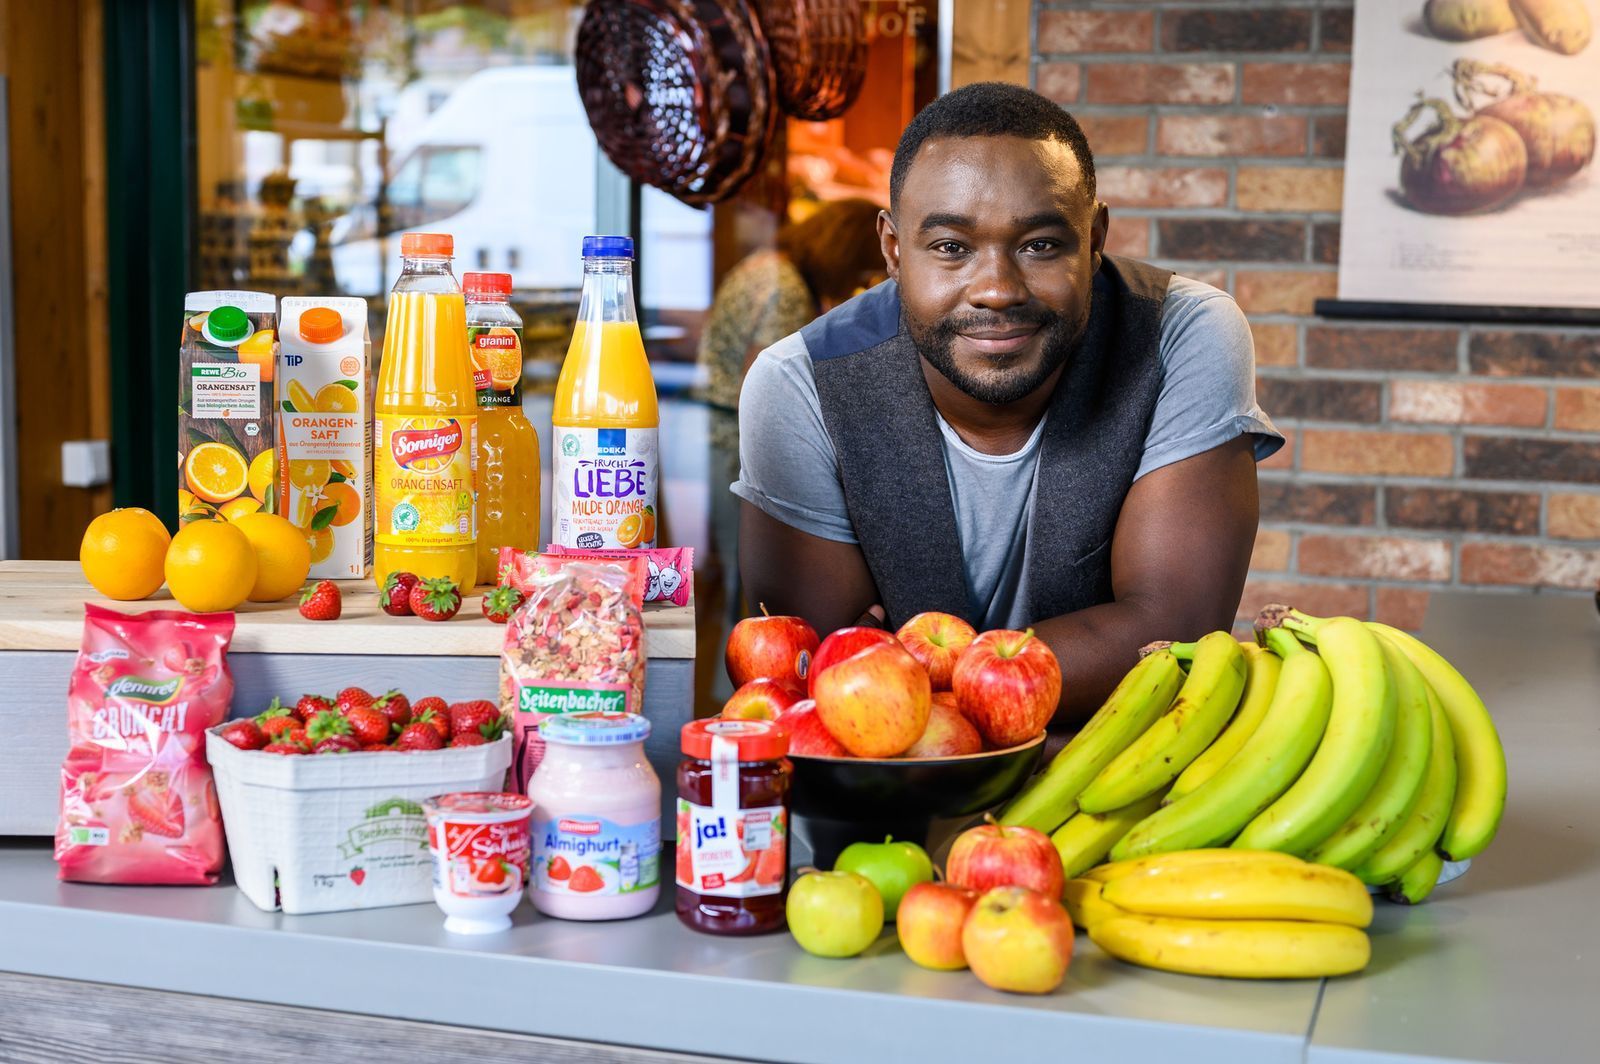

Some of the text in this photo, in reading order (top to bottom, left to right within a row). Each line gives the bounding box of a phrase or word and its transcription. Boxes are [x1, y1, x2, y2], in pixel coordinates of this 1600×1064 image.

[479, 336, 513, 348] granini
[221, 367, 247, 379] Bio
[196, 383, 256, 391] ORANGENSAFT
[292, 418, 358, 428] ORANGEN-
[311, 430, 340, 440] SAFT
[395, 432, 459, 456] Sonniger
[594, 459, 629, 468] FRUCHT
[391, 479, 463, 490] ORANGENSAFT
[574, 468, 647, 498] LIEBE
[572, 499, 645, 516] MILDE ORANGE
[108, 677, 178, 697] dennree
[520, 687, 625, 712] Seitenbacher
[93, 702, 189, 739] CRUNCHY
[695, 816, 727, 849] ja!
[545, 834, 620, 856] Almighurt
